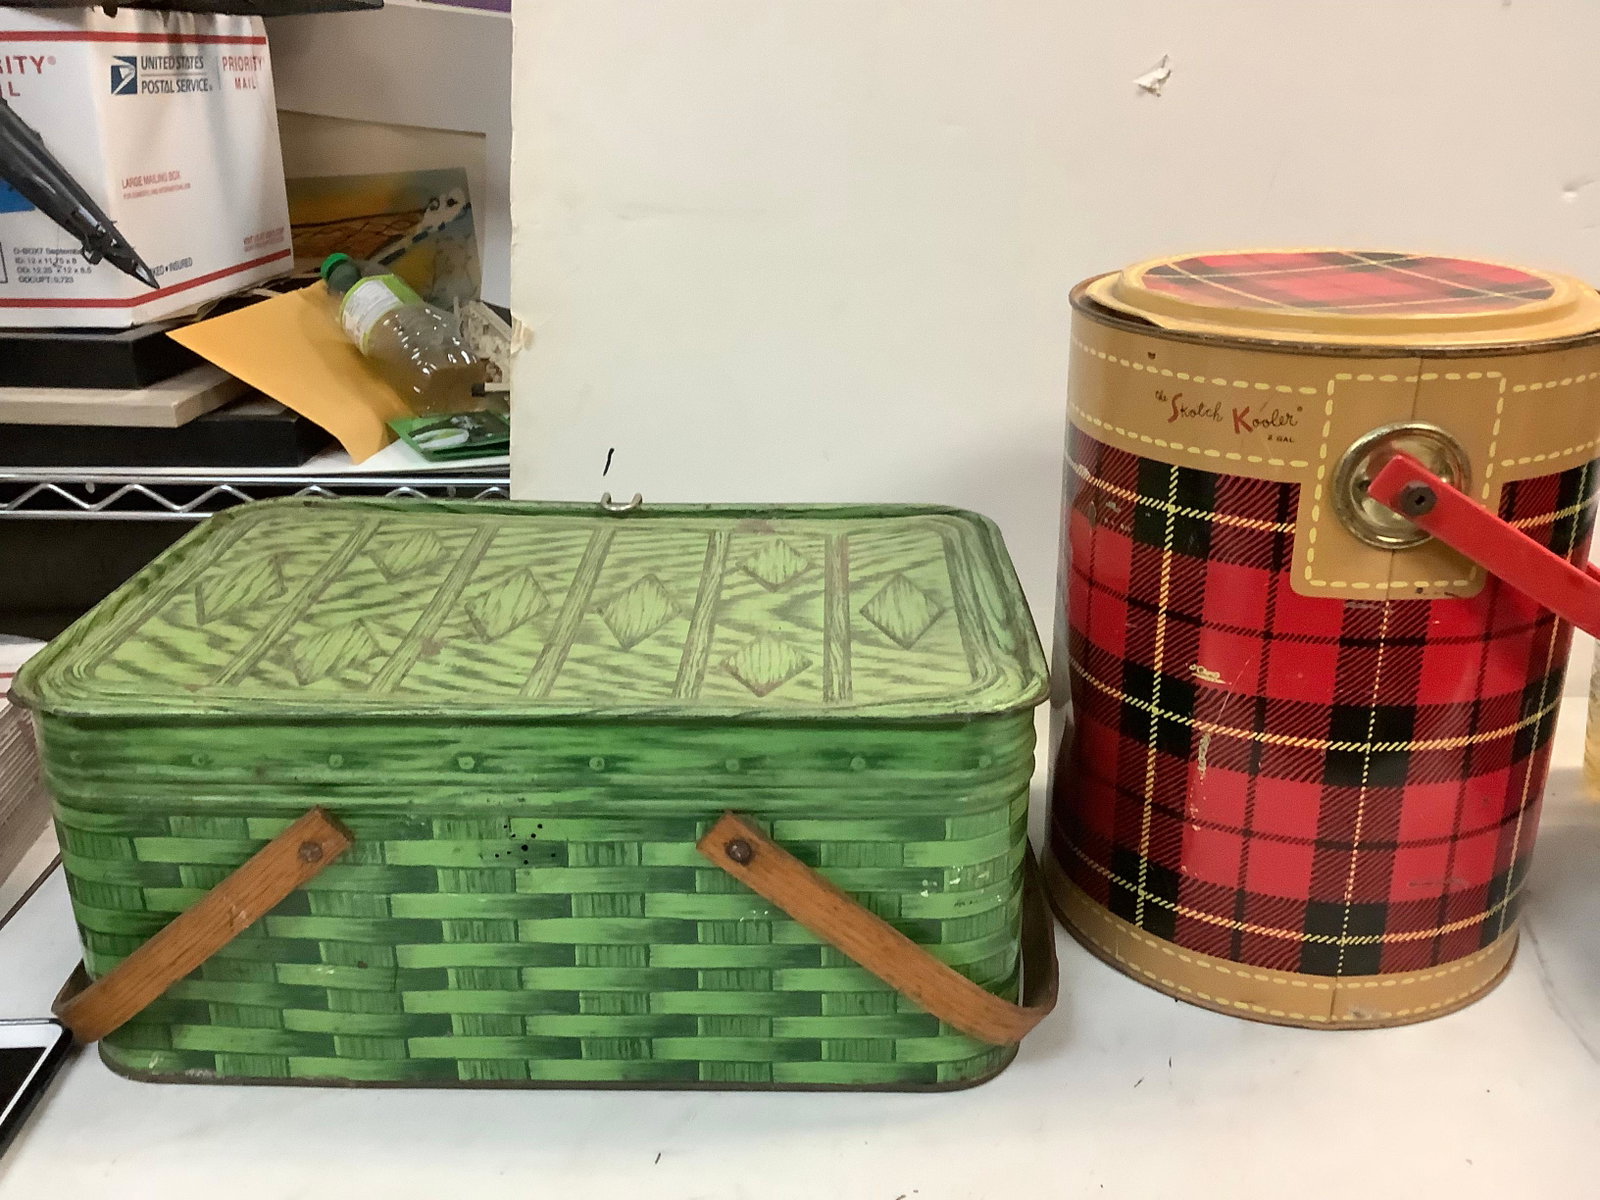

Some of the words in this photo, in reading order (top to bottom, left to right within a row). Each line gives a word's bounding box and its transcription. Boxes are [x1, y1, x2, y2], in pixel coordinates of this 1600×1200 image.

[141, 56, 175, 70] UNITED
[175, 56, 205, 70] STATES
[221, 55, 263, 71] PRIORITY
[141, 79, 175, 94] POSTAL
[235, 77, 257, 90] MAIL
[121, 175, 143, 189] LARGE
[168, 170, 181, 181] BOX
[1167, 392, 1223, 423] Skotch
